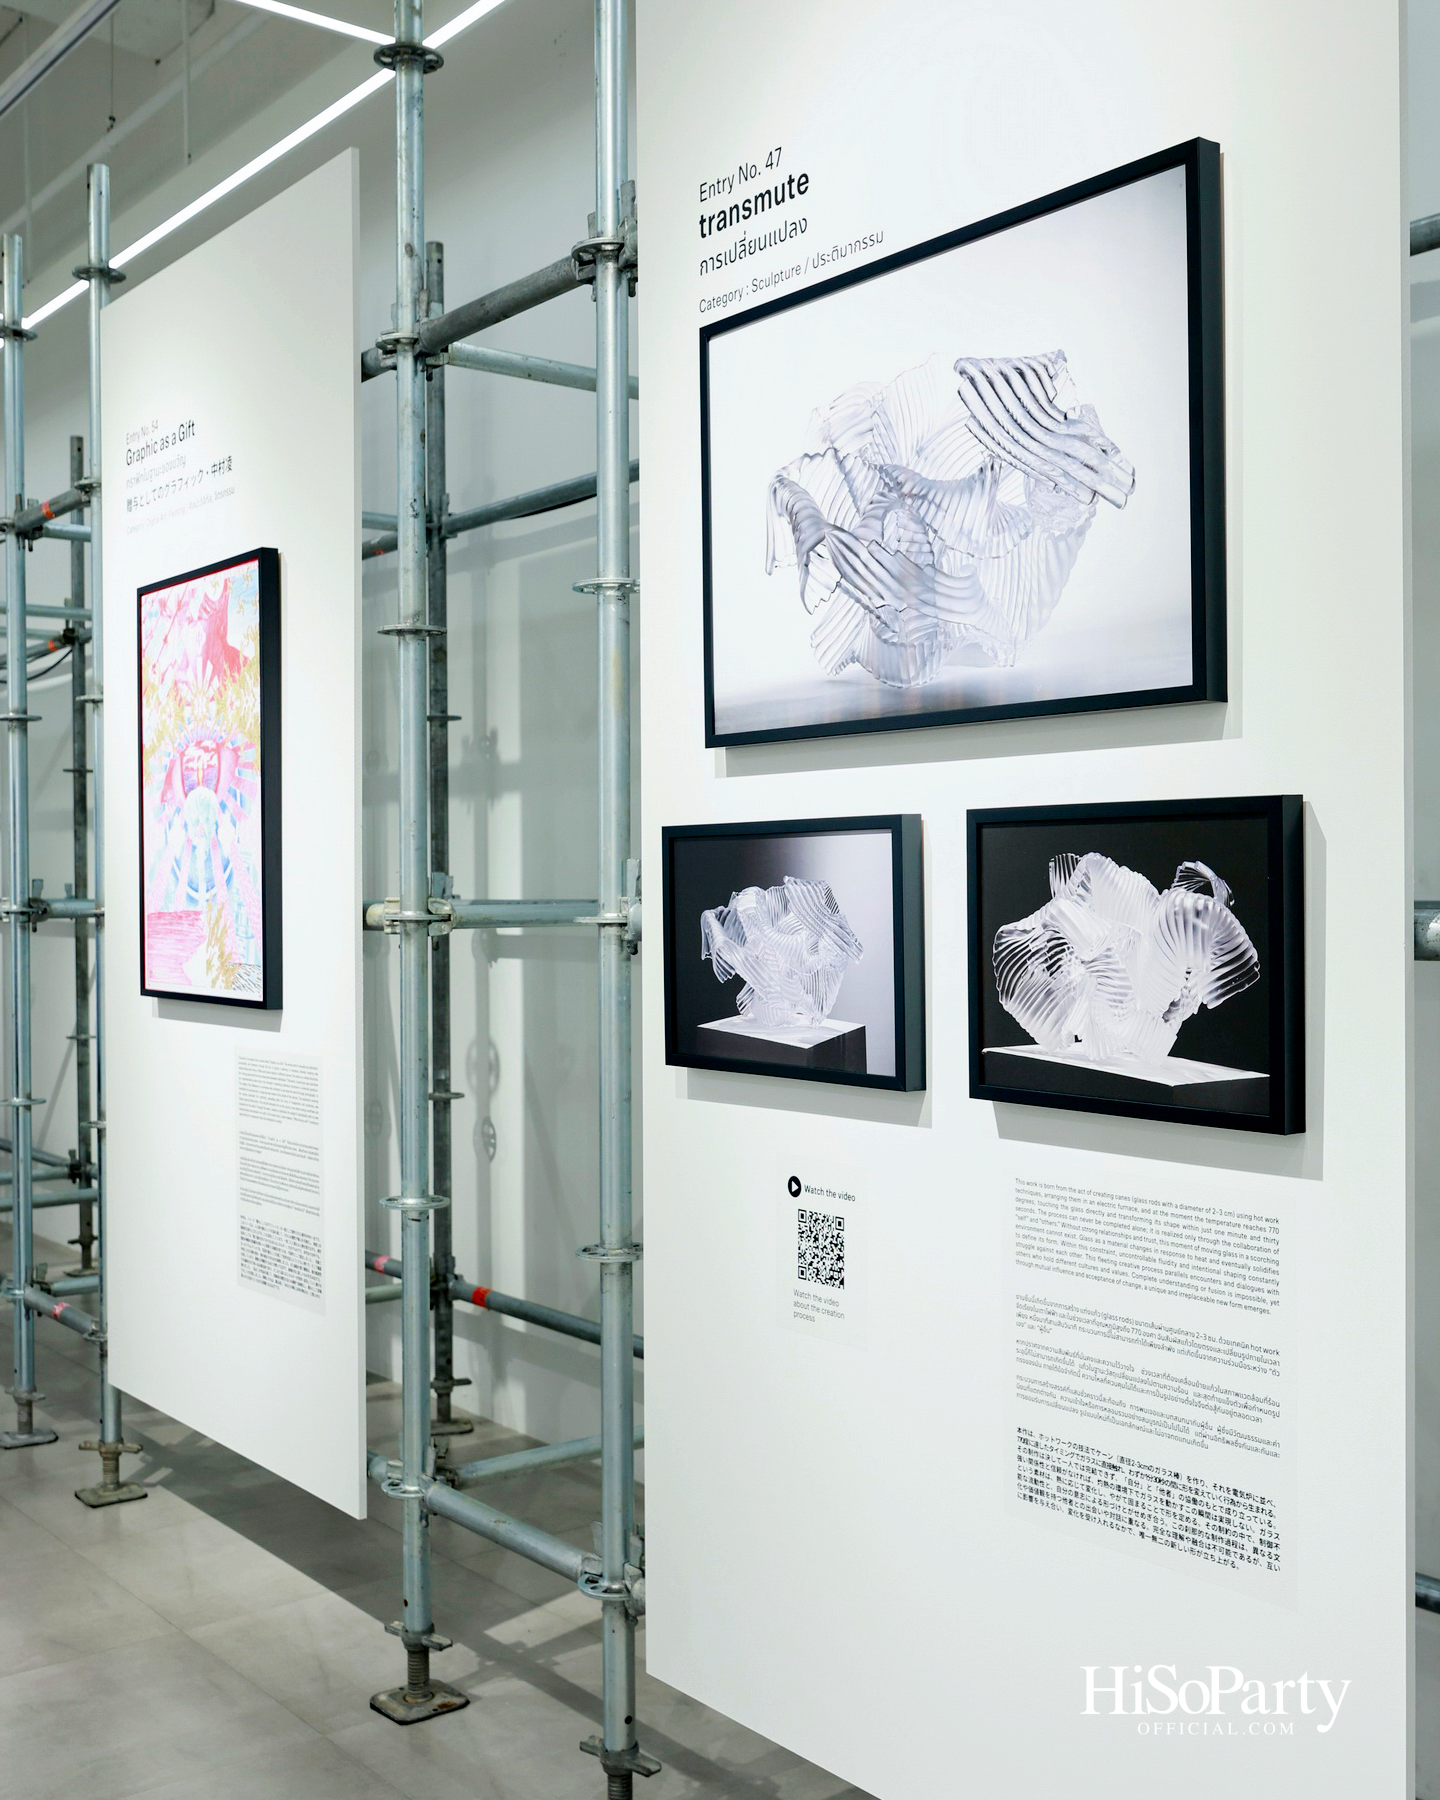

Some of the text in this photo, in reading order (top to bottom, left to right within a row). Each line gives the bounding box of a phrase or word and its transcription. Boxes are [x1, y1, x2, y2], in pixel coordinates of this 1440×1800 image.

[699, 147, 782, 203] Entry No. 47
[699, 173, 809, 239] transmute
[700, 217, 808, 276] การเปลี่ยนแปลง
[752, 263, 801, 293] Sculpture
[812, 231, 884, 269] ประติมากรรม
[126, 427, 140, 445] Entry
[152, 419, 158, 433] 54
[126, 420, 195, 466] Graphic as a Gift
[804, 1184, 855, 1202] Watch the video
[1026, 1179, 1037, 1187] work
[1043, 1182, 1055, 1190] born
[1092, 1190, 1114, 1200] creating
[1131, 1195, 1147, 1205] (glass
[1148, 1198, 1160, 1206] rods
[1161, 1200, 1173, 1208] with
[1178, 1203, 1204, 1213] diameter
[1211, 1208, 1223, 1216] 2-3
[1223, 1209, 1235, 1219] cm)
[1235, 1211, 1252, 1222] using
[1253, 1214, 1263, 1222] hot
[1264, 1216, 1279, 1224] work
[1043, 1191, 1067, 1202] arranging
[1068, 1195, 1081, 1203] them
[1096, 1199, 1116, 1208] electric
[1140, 1206, 1151, 1214] and
[1159, 1209, 1169, 1217] the
[1169, 1211, 1193, 1221] moment
[1205, 1216, 1241, 1230] temperature
[1242, 1222, 1268, 1232] reaches
[1267, 1226, 1279, 1234] 770
[1029, 1216, 1038, 1224] and
[1060, 1222, 1080, 1231] Without
[1081, 1225, 1098, 1235] strong
[1098, 1228, 1132, 1241] relationships
[1132, 1234, 1143, 1242] and
[1158, 1238, 1169, 1246] this
[1170, 1240, 1193, 1250] moment
[1200, 1245, 1221, 1257] moving
[1222, 1249, 1238, 1259] glass
[1249, 1254, 1279, 1267] scorching
[1037, 1199, 1059, 1210] touching
[1070, 1205, 1083, 1214] glass
[1085, 1207, 1105, 1218] directly
[1105, 1210, 1116, 1218] and
[1118, 1212, 1152, 1225] transforming
[1163, 1219, 1180, 1230] shape
[1181, 1222, 1199, 1231] within
[1200, 1225, 1212, 1235] just
[1226, 1230, 1247, 1239] minute
[1248, 1233, 1261, 1241] and
[1262, 1235, 1279, 1246] thirty
[1047, 1212, 1067, 1221] process
[1102, 1219, 1130, 1231] completed
[1160, 1229, 1183, 1239] realized
[1184, 1233, 1196, 1242] only
[1197, 1235, 1220, 1246] through
[1221, 1239, 1231, 1247] the
[1232, 1241, 1271, 1253] collaboration
[1015, 1223, 1045, 1233] environment
[1045, 1228, 1063, 1237] cannot
[1078, 1234, 1093, 1242] Glass
[1106, 1238, 1128, 1248] material
[1129, 1242, 1152, 1254] changes
[1159, 1249, 1186, 1260] response
[1194, 1254, 1207, 1262] heat
[1208, 1256, 1220, 1264] and
[1220, 1258, 1252, 1271] eventually
[1251, 1264, 1279, 1275] solidifies
[793, 1288, 839, 1307] Watch the video
[793, 1300, 844, 1319] about the creation
[793, 1310, 815, 1322] process
[1250, 1343, 1261, 1352] hot
[1263, 1346, 1279, 1356] work
